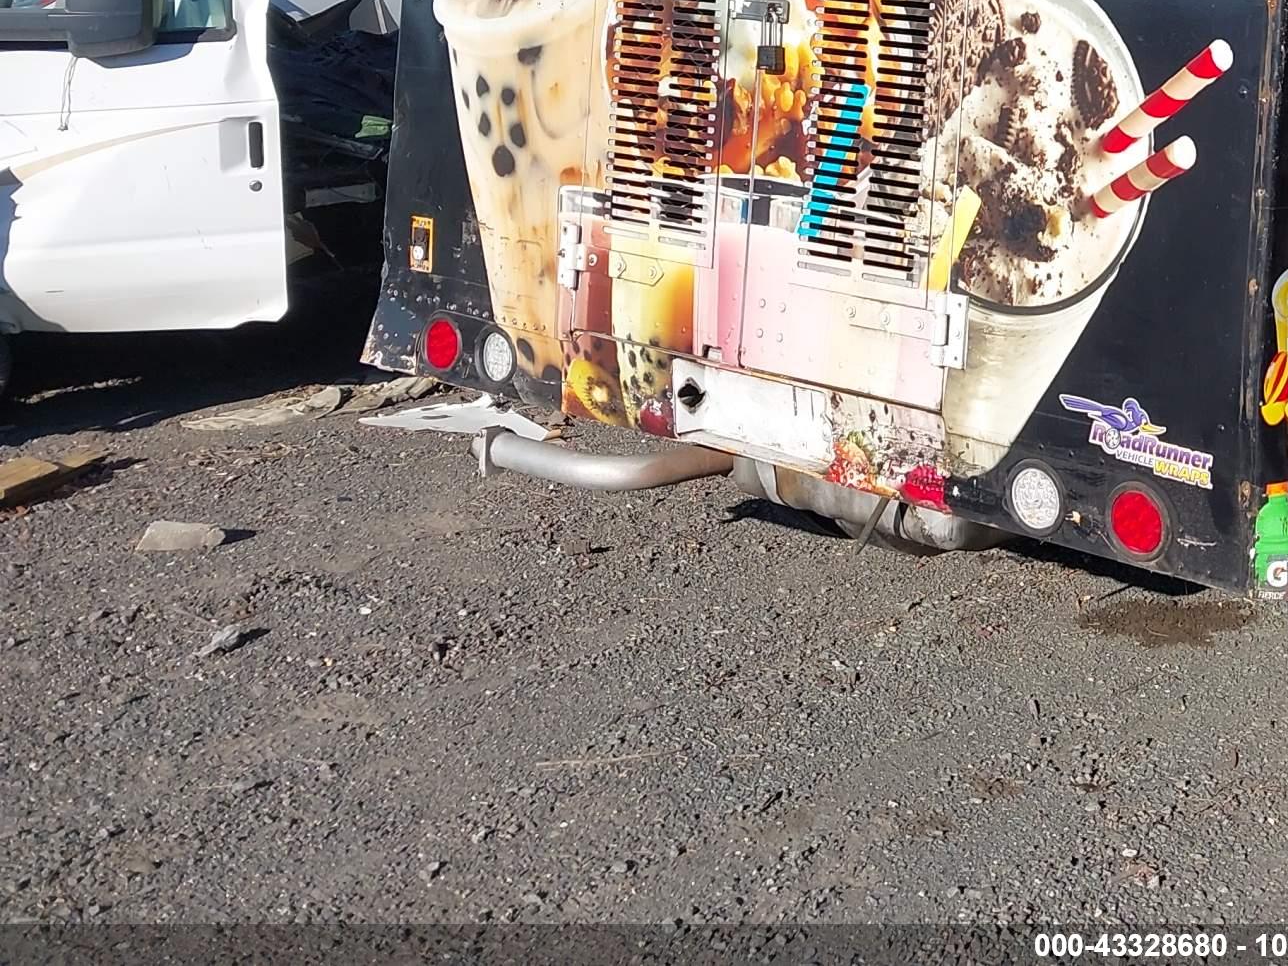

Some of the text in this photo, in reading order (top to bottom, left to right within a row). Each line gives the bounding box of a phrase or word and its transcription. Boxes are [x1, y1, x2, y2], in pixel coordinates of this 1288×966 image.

[1116, 449, 1210, 484] VEHICLE WRAPS
[1266, 560, 1288, 588] G
